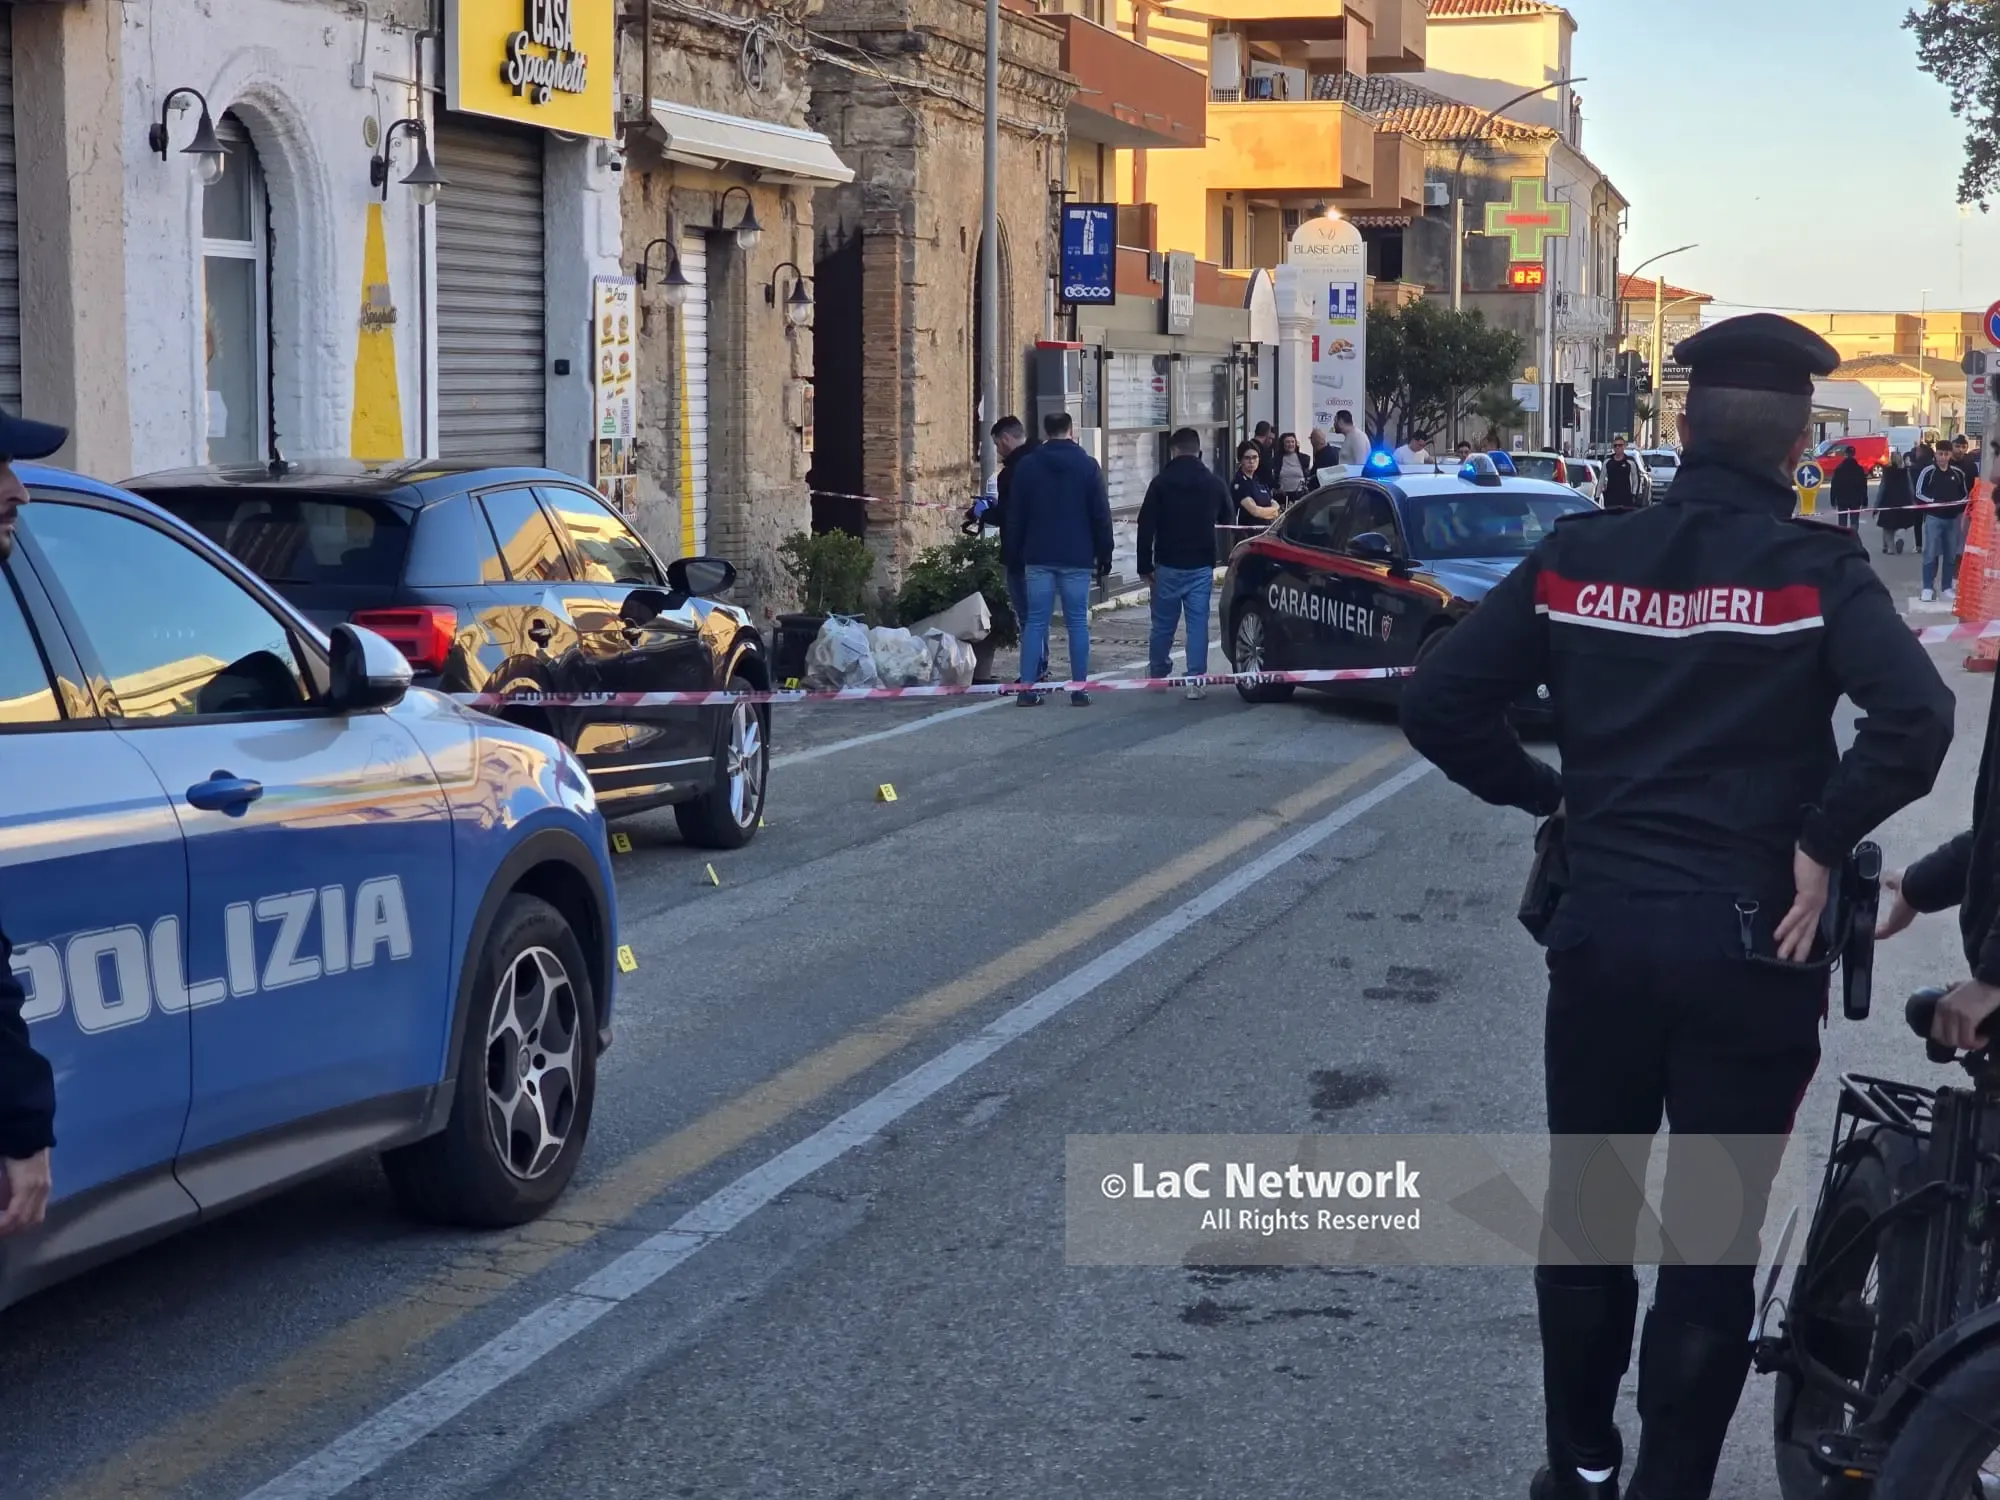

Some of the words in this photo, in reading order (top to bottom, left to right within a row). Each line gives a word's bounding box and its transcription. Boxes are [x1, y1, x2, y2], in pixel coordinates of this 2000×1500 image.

[530, 0, 574, 51] CASA
[506, 30, 589, 105] Spaghetti
[1294, 244, 1329, 255] BLAISE
[1268, 583, 1374, 637] CARABINIERI
[1576, 584, 1764, 627] CARABINIERI
[616, 834, 629, 849] E
[8, 874, 412, 1035] POLIZIA
